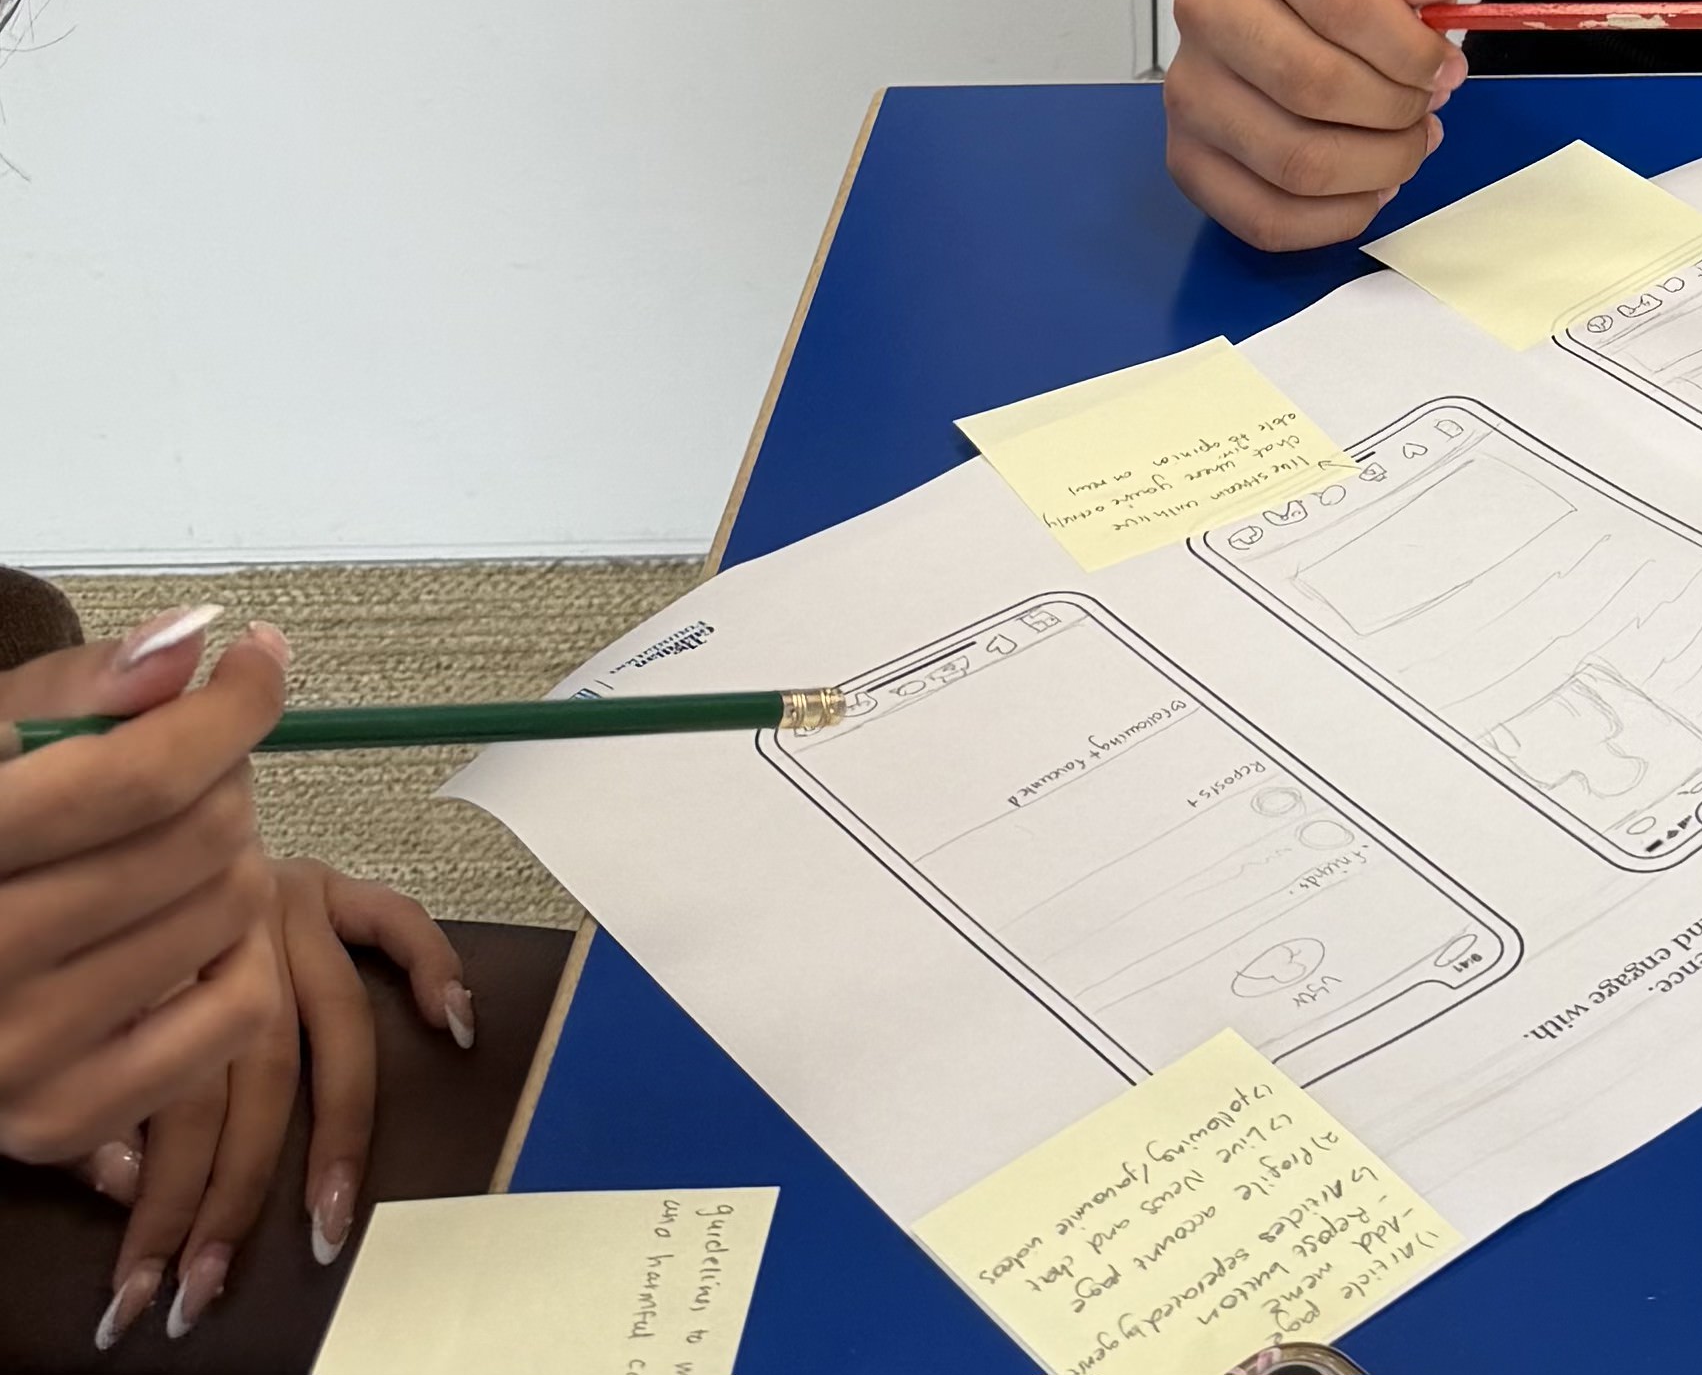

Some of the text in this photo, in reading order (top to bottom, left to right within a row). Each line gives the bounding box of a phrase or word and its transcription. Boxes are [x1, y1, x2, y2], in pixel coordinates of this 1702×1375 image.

[1451, 953, 1484, 974] 9:41
[1588, 947, 1672, 1004] engage
[1523, 1003, 1590, 1040] with.
[1024, 1126, 1269, 1294] Live News and chat
[1137, 1205, 1217, 1271] account
[626, 1253, 675, 1340] harmful
[1069, 1264, 1123, 1314] page
